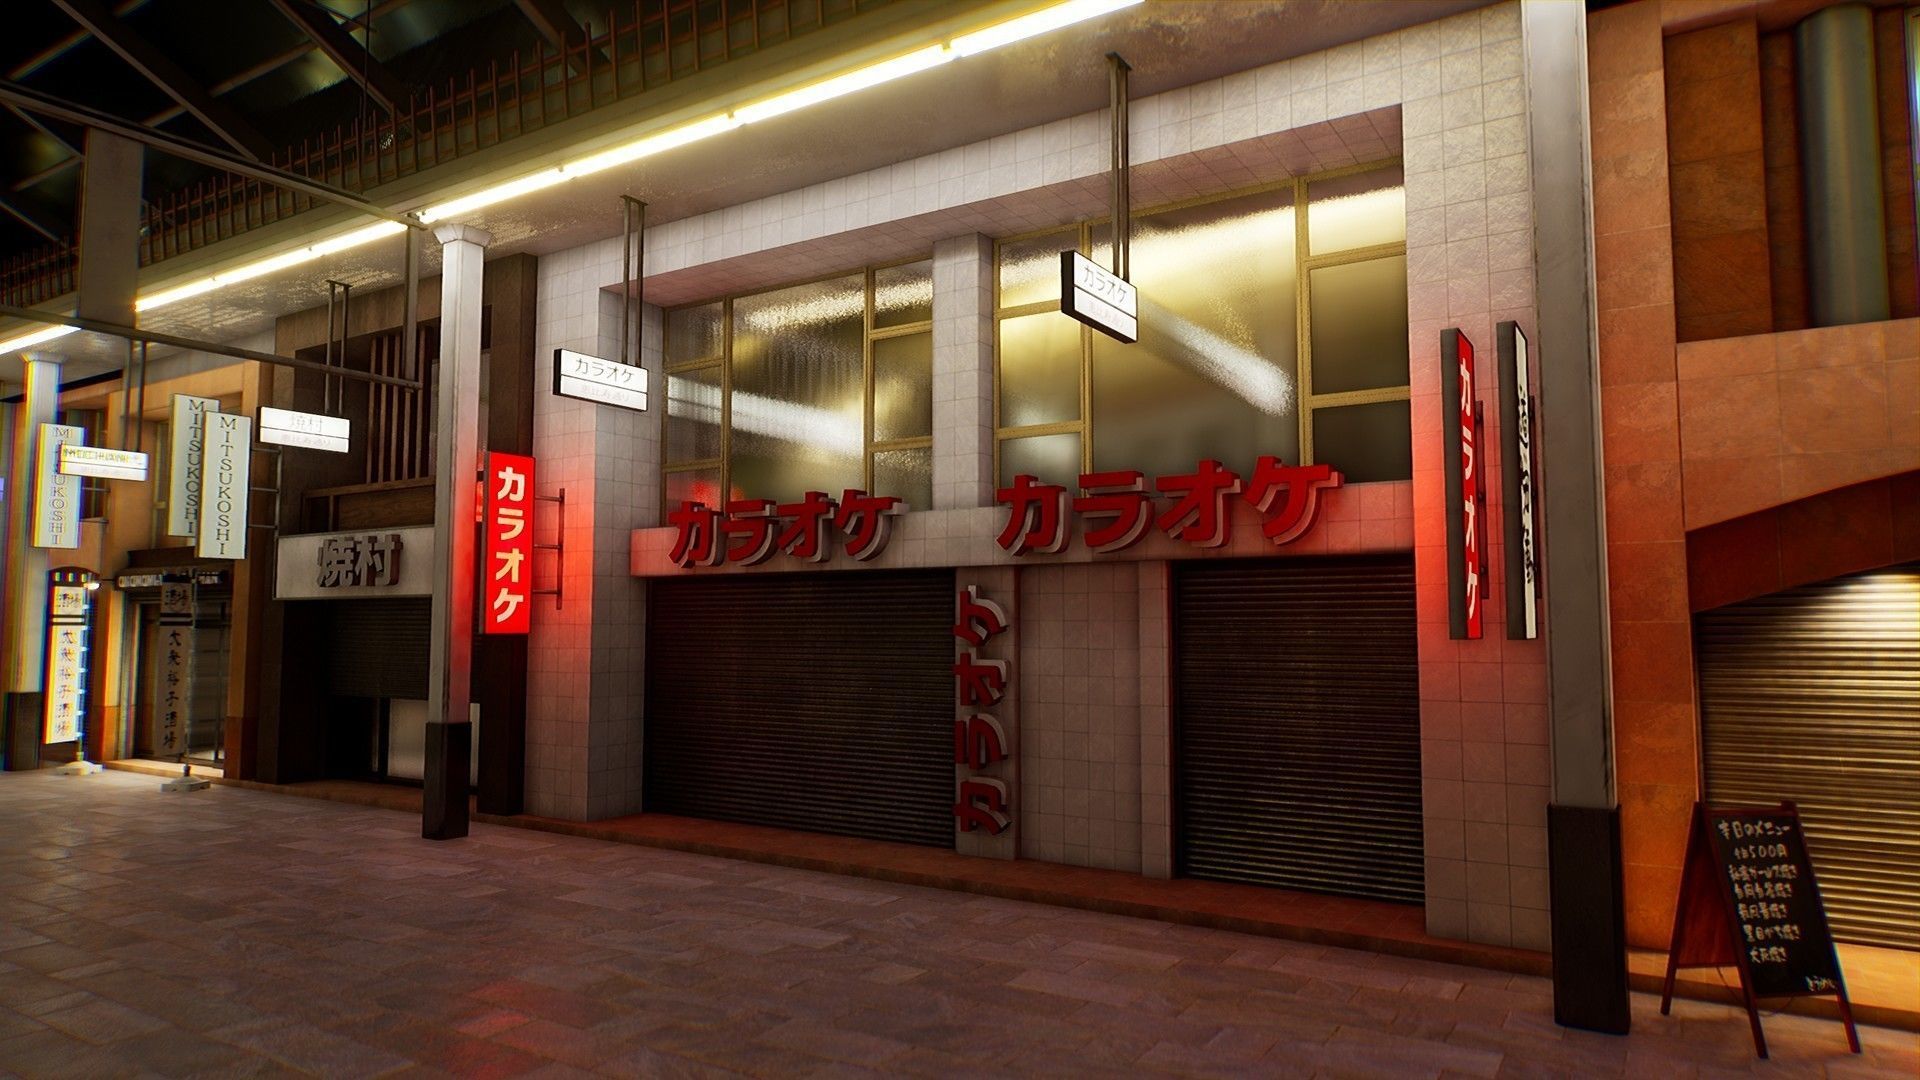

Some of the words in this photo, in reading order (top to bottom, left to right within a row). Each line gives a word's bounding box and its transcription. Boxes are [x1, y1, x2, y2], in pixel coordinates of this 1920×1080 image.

[1083, 265, 1127, 303] カラオケ
[575, 358, 635, 383] カラオケ
[49, 426, 73, 545] MUKOSHI
[187, 399, 205, 534] MITSUKOSHI
[216, 416, 236, 555] MITSUKOSHI
[667, 488, 903, 569] カラオケ
[996, 455, 1344, 555] カラオケ
[1460, 358, 1477, 619] カラオケ
[493, 466, 525, 623] カラオケ
[953, 584, 1011, 836] カラオケ
